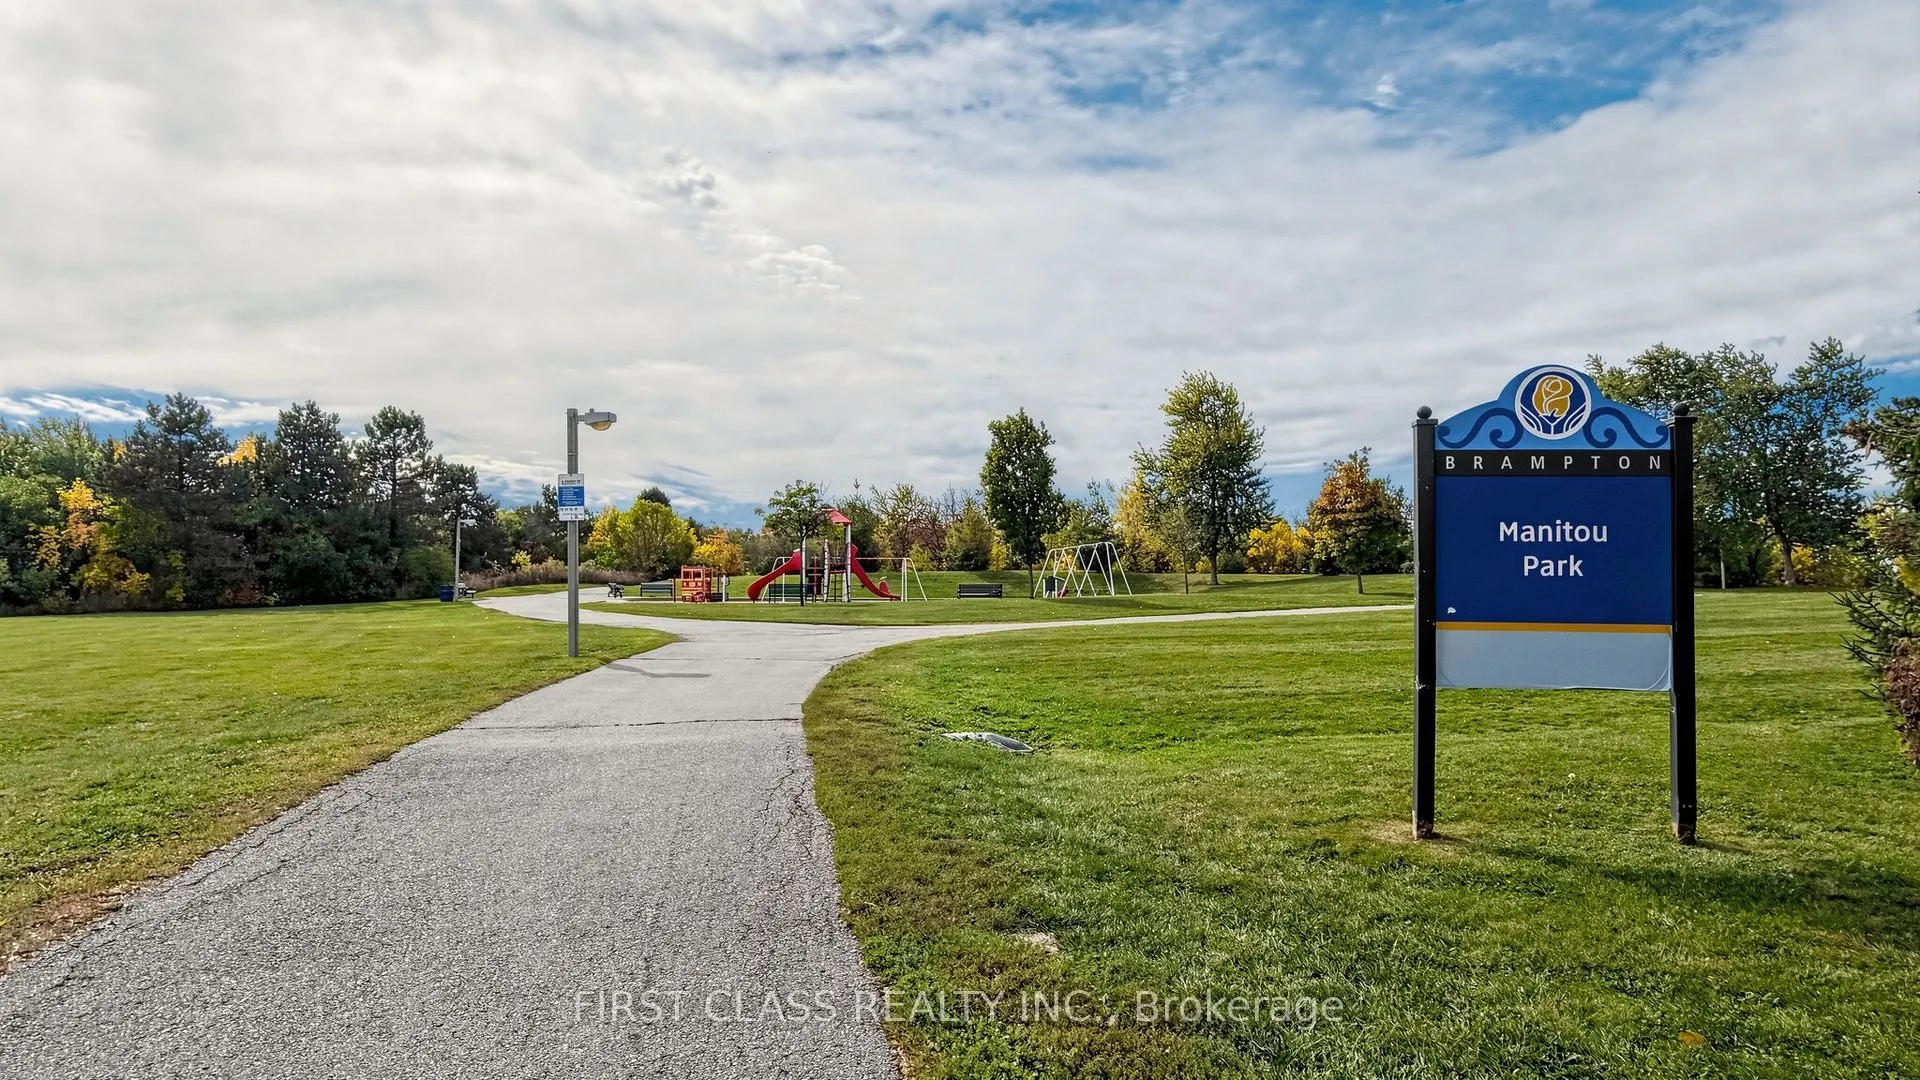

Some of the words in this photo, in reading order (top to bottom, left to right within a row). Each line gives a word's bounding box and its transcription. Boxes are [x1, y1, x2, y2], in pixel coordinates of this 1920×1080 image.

[1445, 455, 1661, 470] BRAMPTON
[1499, 519, 1608, 542] Manitou
[1523, 555, 1584, 577] Park
